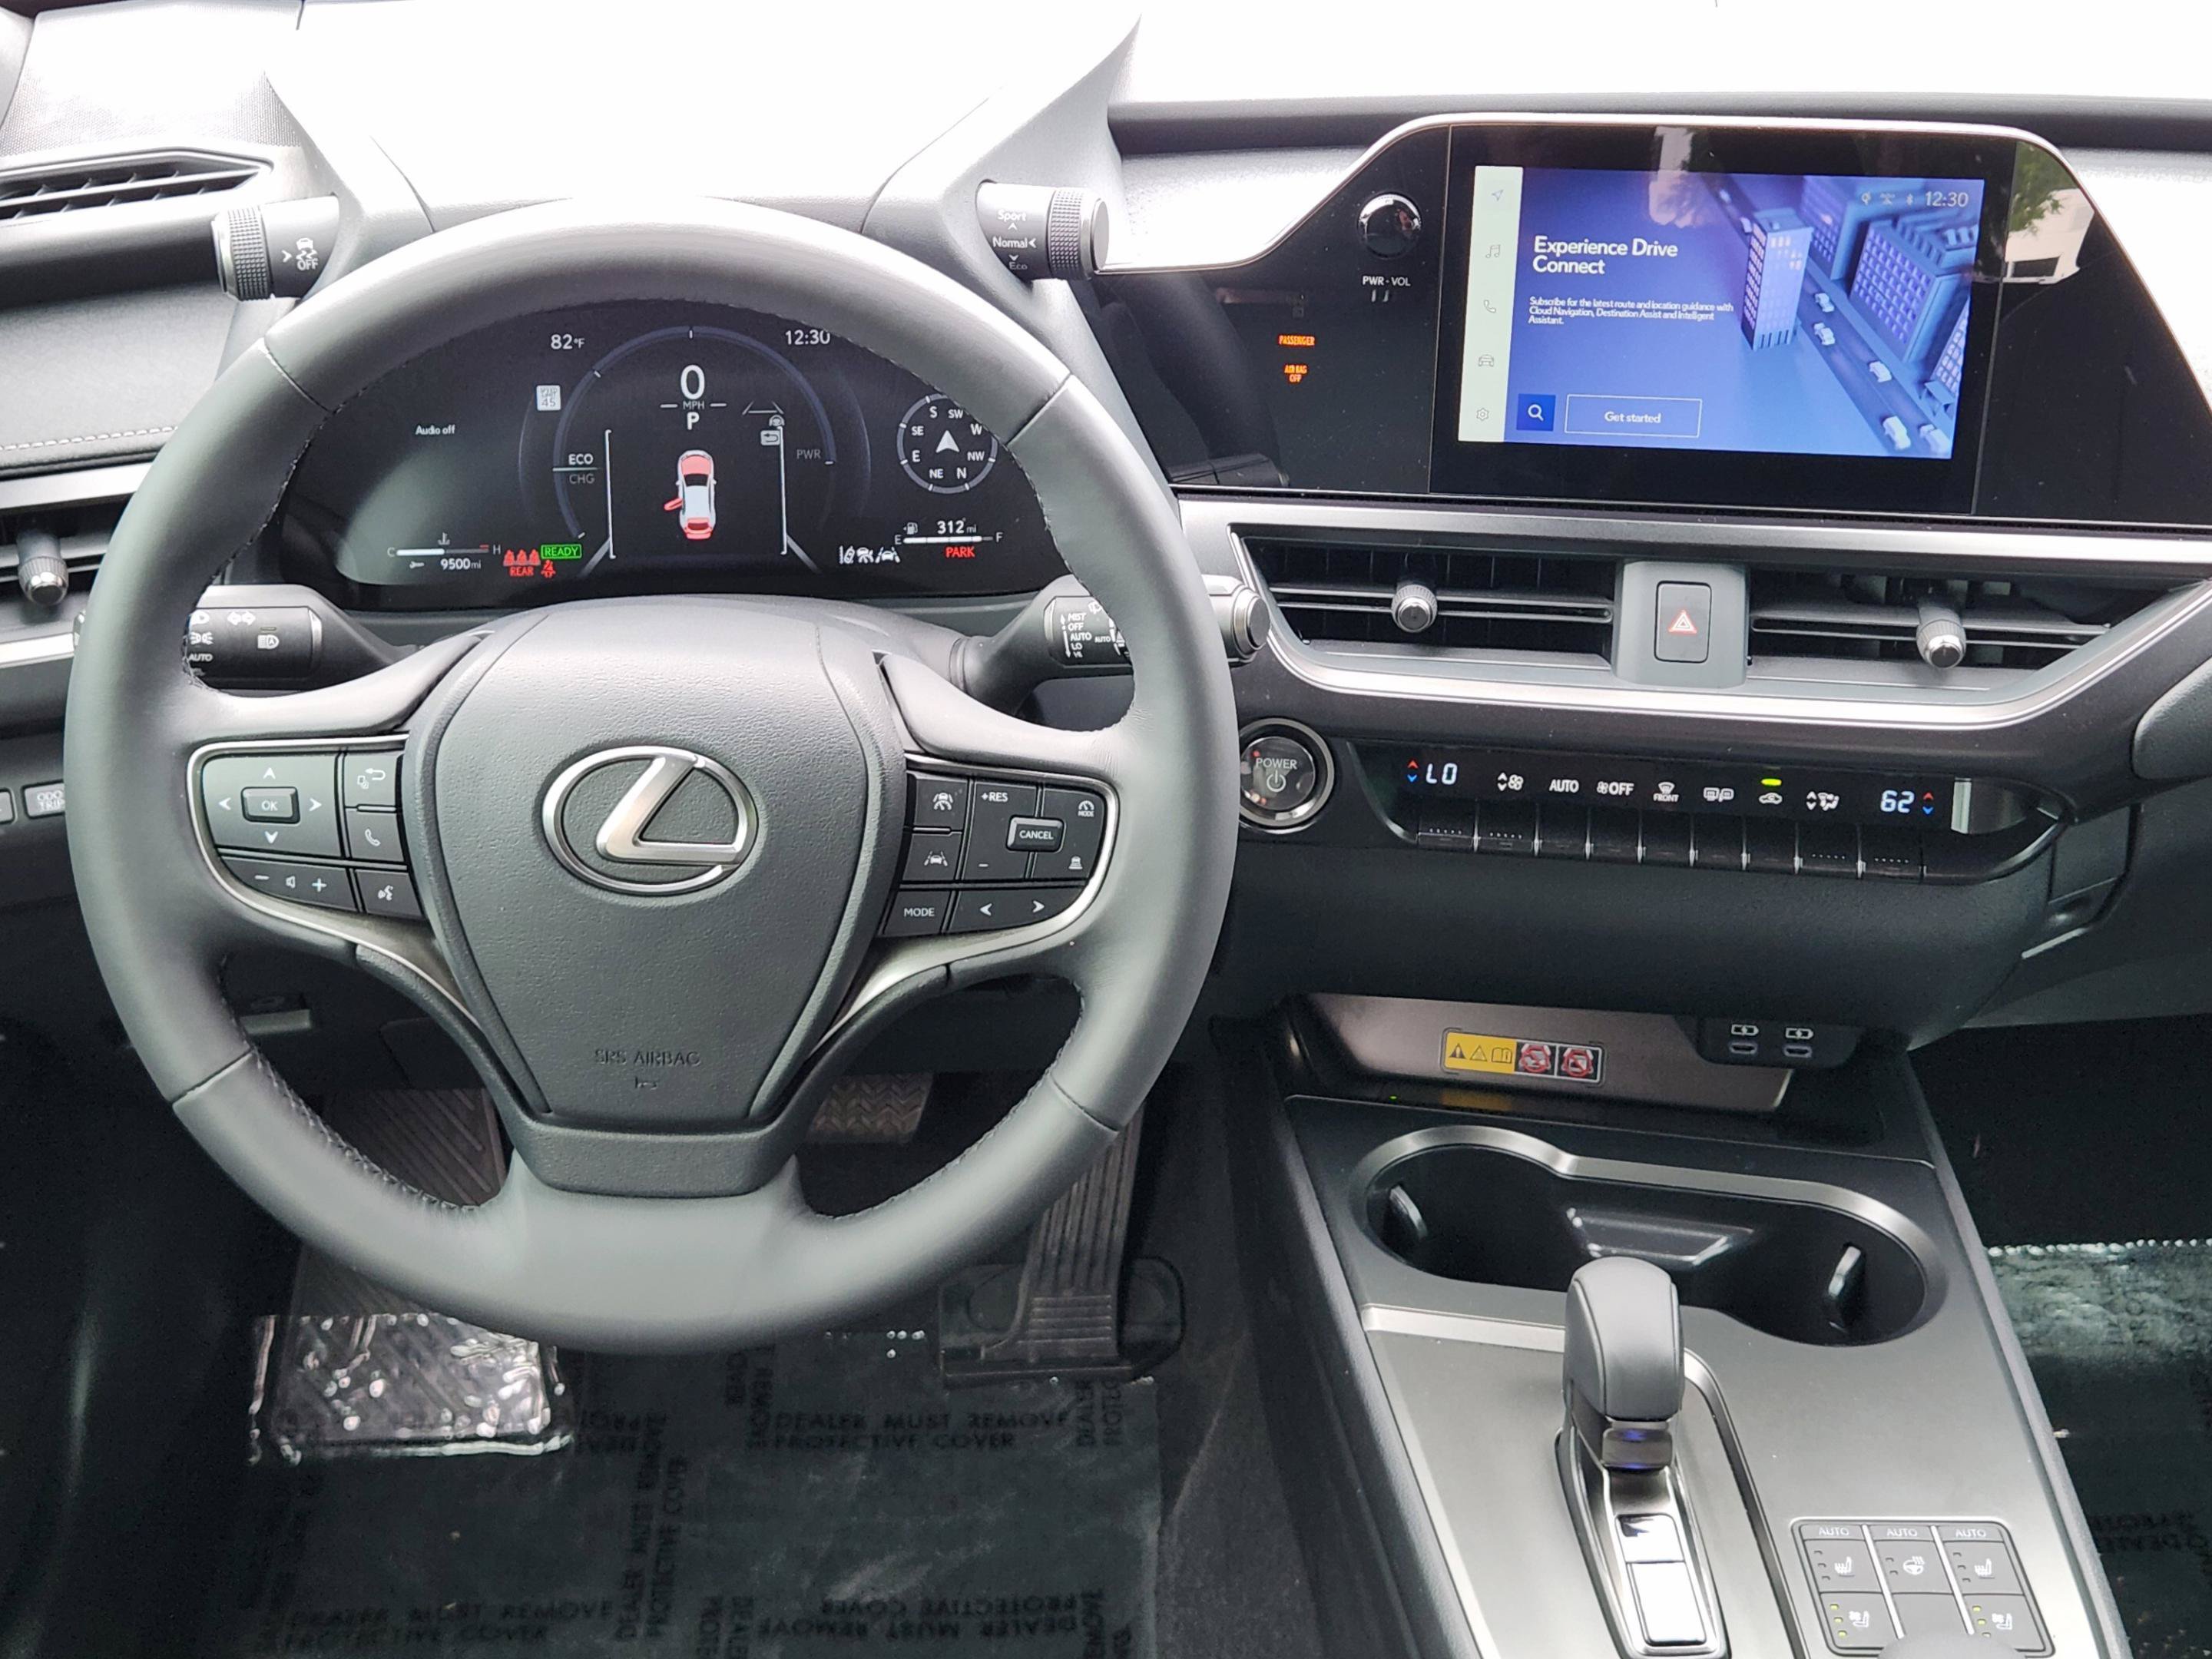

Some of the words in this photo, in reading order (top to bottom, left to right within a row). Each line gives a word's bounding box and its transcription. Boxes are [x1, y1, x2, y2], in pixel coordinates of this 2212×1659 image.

[1926, 191, 1969, 207] 12:30
[998, 210, 1027, 222] Sport
[992, 236, 1028, 249] Normal
[1534, 235, 1628, 257] Experience
[1631, 238, 1678, 257] Drive
[297, 259, 318, 271] OFF
[1533, 255, 1605, 274] Connect
[1363, 276, 1384, 285] PWR
[1391, 276, 1411, 286] VOL
[1529, 296, 1565, 306] Subscribe
[1567, 297, 1578, 306] for
[1579, 298, 1592, 307] the
[1593, 299, 1614, 308] latest
[1614, 300, 1635, 309] route
[1636, 300, 1651, 309] and
[1651, 300, 1681, 310] location
[1681, 302, 1715, 312] guidance
[1716, 303, 1734, 312] with
[1529, 306, 1552, 315] Cloud
[1553, 307, 1595, 318] Navigation,
[1596, 308, 1638, 318] Destination
[1639, 309, 1661, 319] Assist
[1663, 310, 1677, 319] and
[1677, 310, 1714, 321] Intelligent
[1528, 316, 1565, 325] Assistant.
[785, 329, 830, 345] 12:30
[1279, 334, 1315, 346] PASSENGER
[680, 364, 705, 399] 0
[683, 401, 704, 409] MPH
[929, 406, 938, 418] S
[948, 409, 963, 419] SW
[1604, 411, 1624, 422] Get
[1626, 412, 1661, 423] started
[687, 412, 700, 430] P
[416, 424, 441, 435] Audio
[442, 424, 455, 435] off
[912, 426, 924, 435] SE
[970, 423, 982, 435] W
[568, 453, 594, 465] ECO
[796, 449, 821, 459] PWR
[912, 450, 920, 462] E
[968, 452, 985, 461] NW
[569, 473, 594, 484] CHG
[929, 469, 944, 478] NE
[957, 467, 966, 479] N
[937, 520, 965, 535] 312
[966, 524, 976, 533] mi
[895, 535, 902, 545] E
[996, 532, 1003, 542] F
[387, 547, 396, 557] C
[493, 545, 501, 555] H
[545, 546, 578, 556] READY
[945, 546, 975, 558] PARK
[510, 567, 534, 576] REAR
[1068, 623, 1084, 631] OFF
[1071, 632, 1092, 641] AUTO
[1071, 642, 1082, 651] LO
[188, 654, 213, 662] AUTO
[1255, 757, 1297, 770] POWER
[1549, 779, 1579, 793] AUTO
[1608, 782, 1634, 796] OFF
[1653, 793, 1679, 802] FRONT
[1880, 790, 1915, 813] 62
[261, 801, 278, 811] OK
[1019, 830, 1053, 840] CANCEL
[904, 908, 935, 917] MODE
[595, 1049, 627, 1065] SRS
[634, 1051, 701, 1067] AIRBAG
[884, 1413, 951, 1430] MUST
[932, 1432, 1016, 1450] COVER
[1818, 1527, 1849, 1537] AUTO
[1886, 1528, 1917, 1537] AUTO
[1955, 1528, 1986, 1538] AUTO
